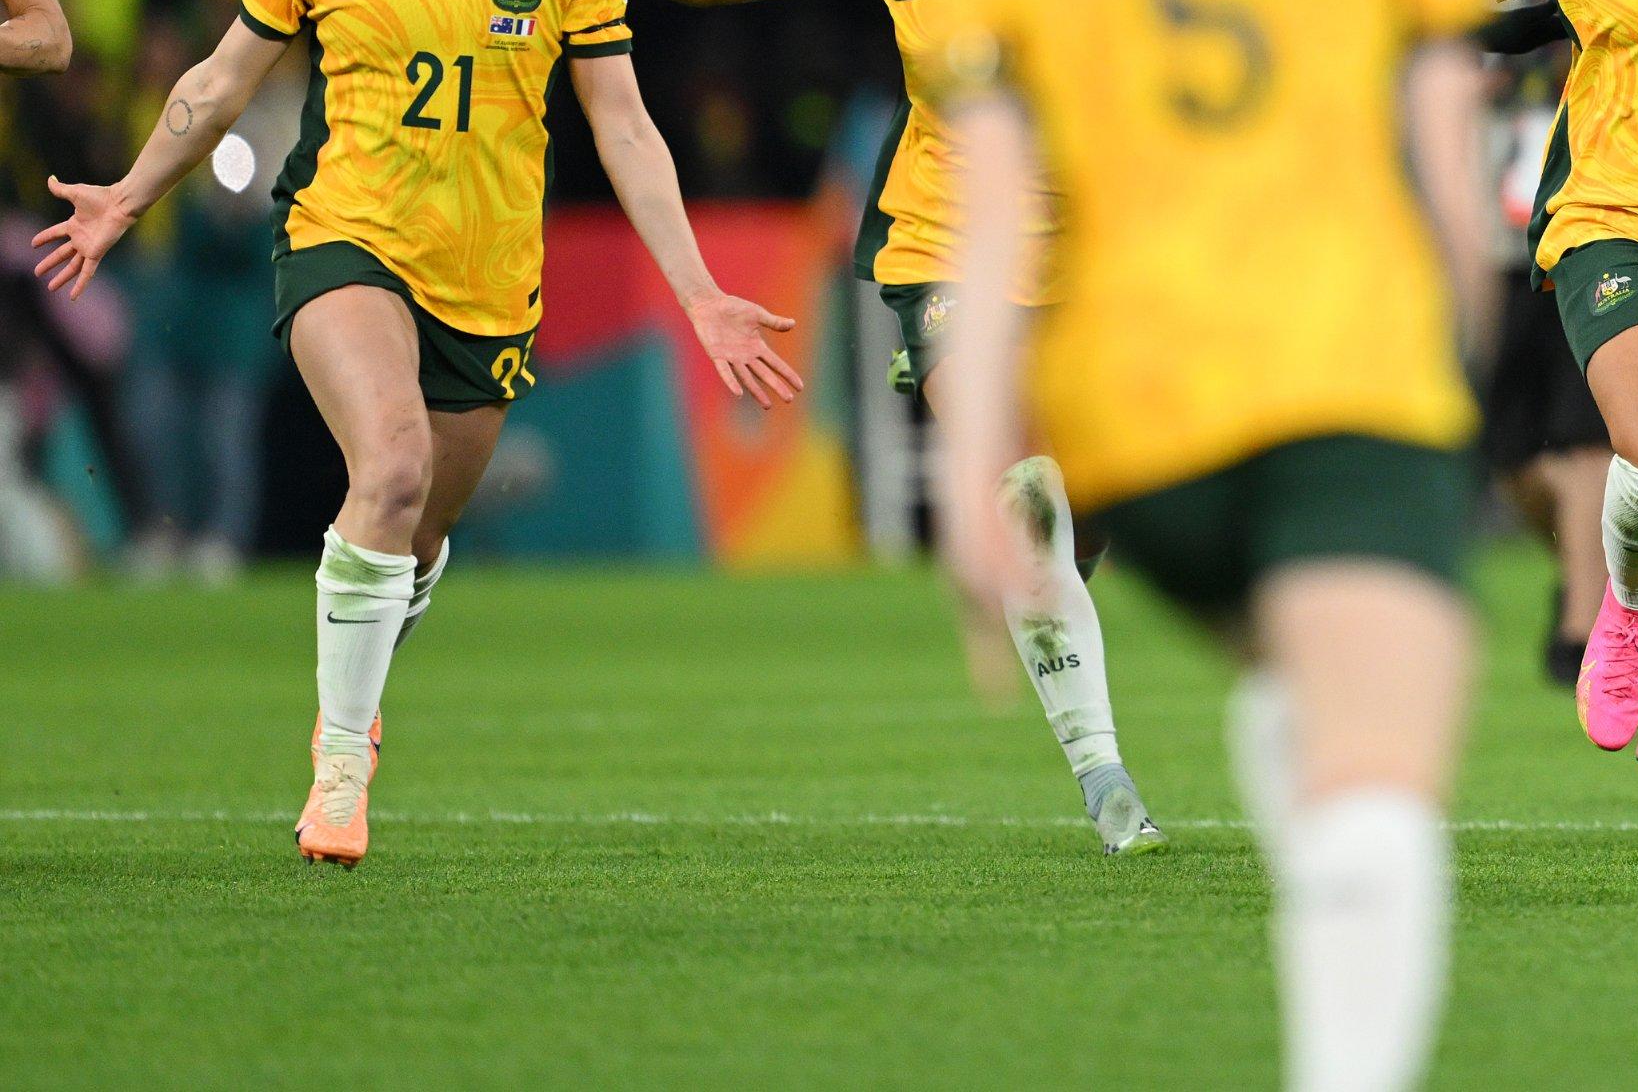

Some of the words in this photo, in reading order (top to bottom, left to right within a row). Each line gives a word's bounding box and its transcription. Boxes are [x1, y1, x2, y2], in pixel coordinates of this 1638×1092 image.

[401, 50, 474, 133] 21
[1597, 288, 1630, 308] AUSTRALIA
[1038, 653, 1081, 677] AUS
